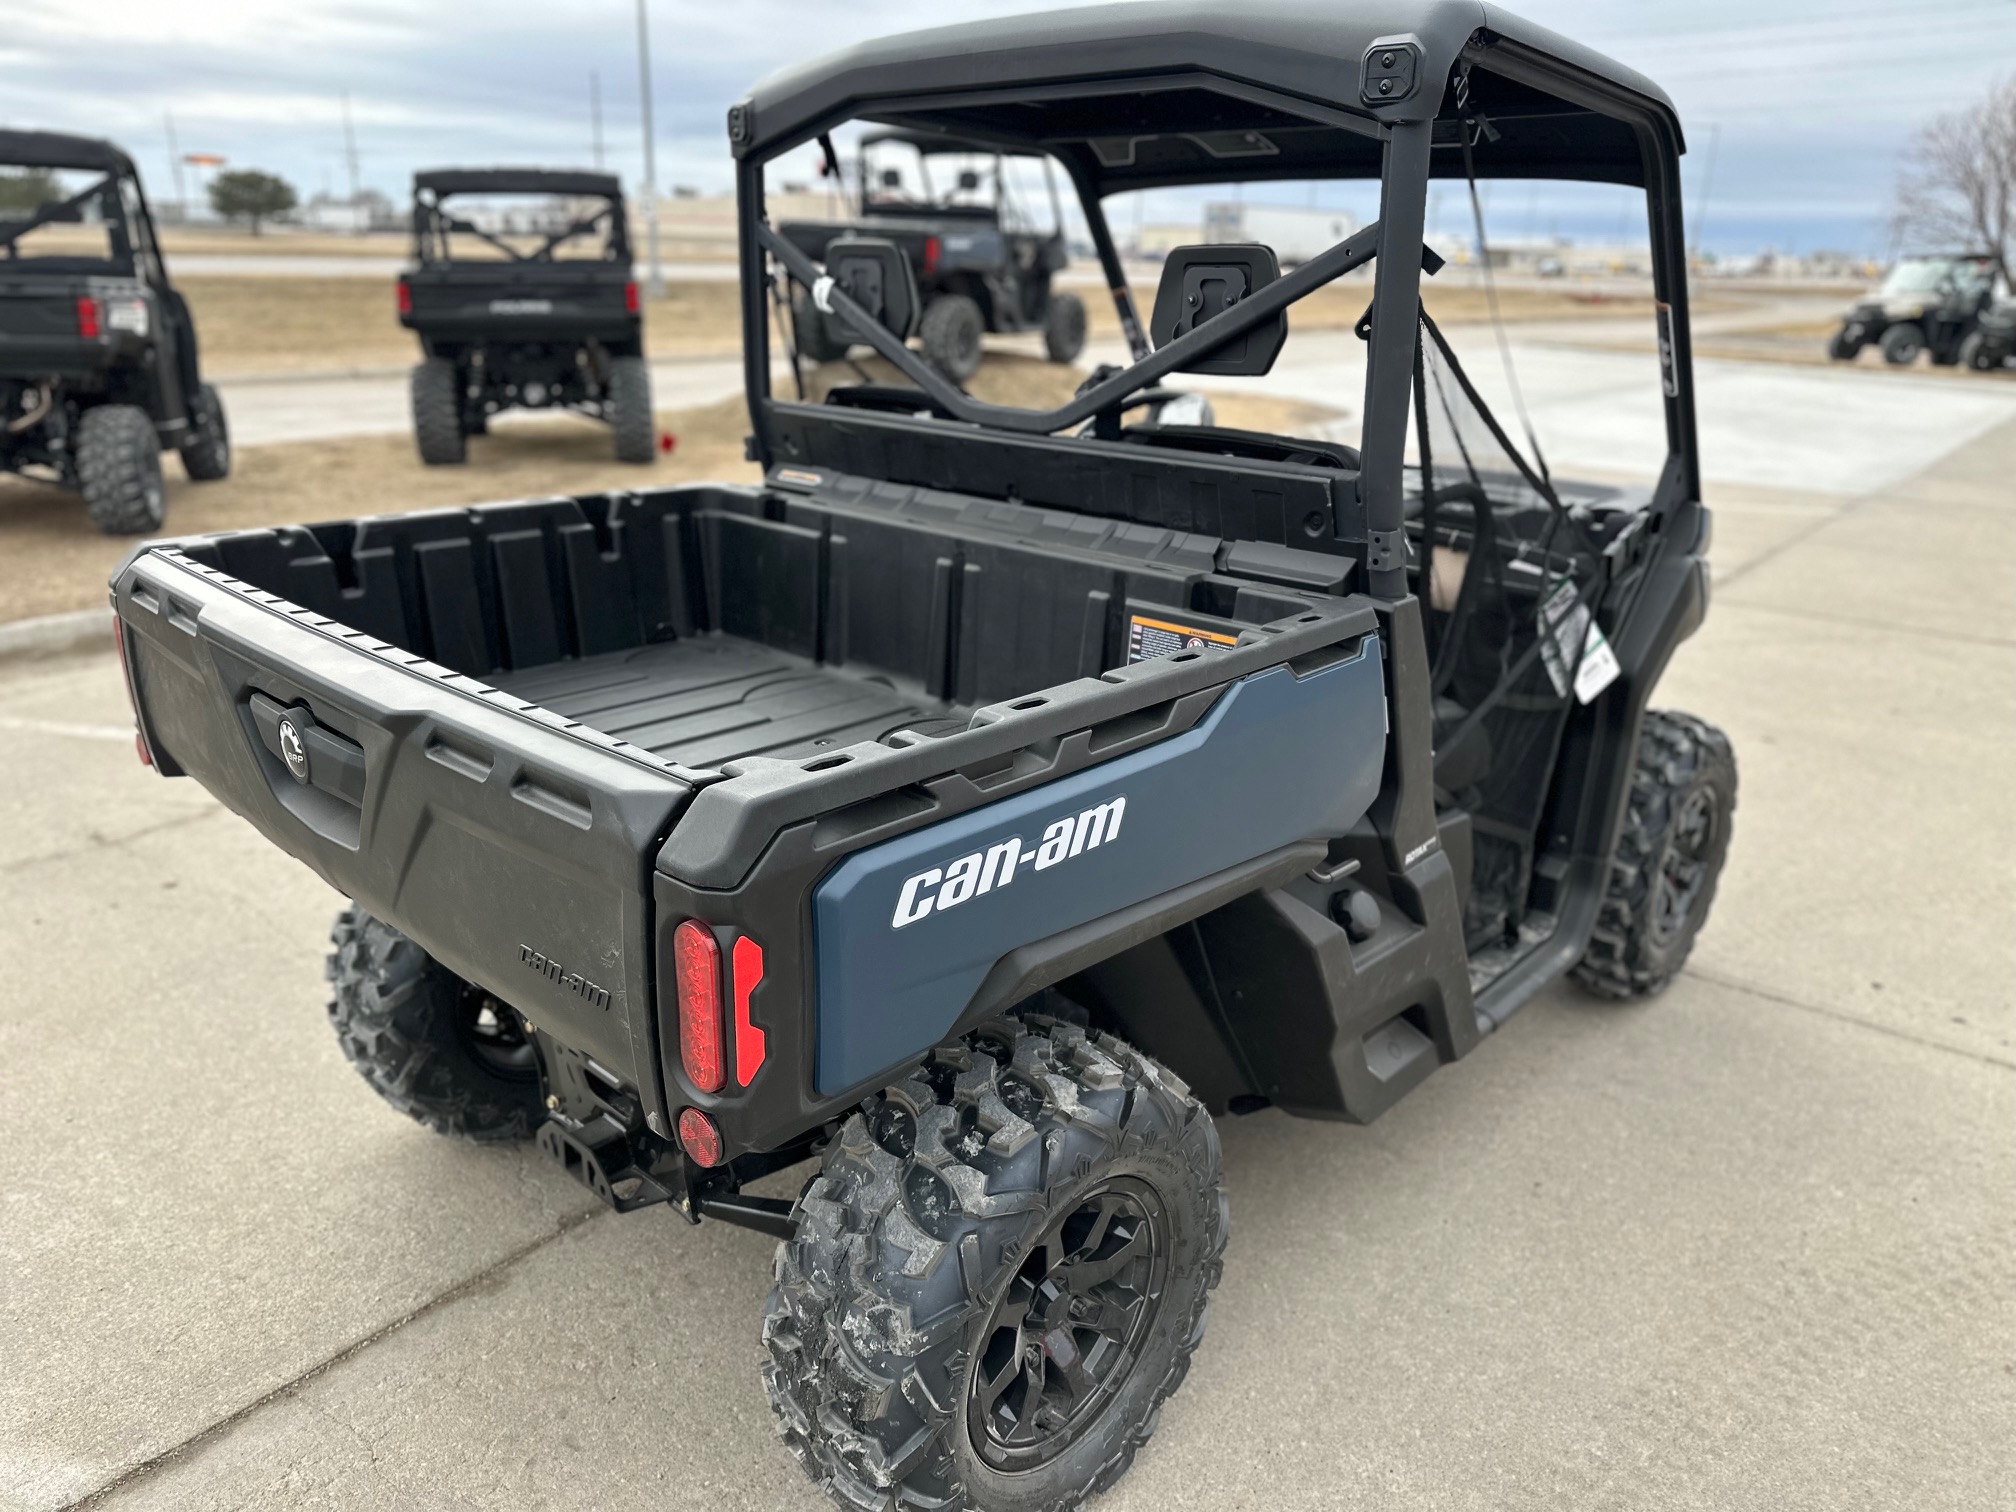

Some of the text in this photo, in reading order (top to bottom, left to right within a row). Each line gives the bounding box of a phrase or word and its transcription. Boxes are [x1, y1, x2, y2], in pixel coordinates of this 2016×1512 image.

[288, 752, 303, 763] BRP
[892, 797, 1126, 928] can-am
[519, 944, 611, 1011] can-am
